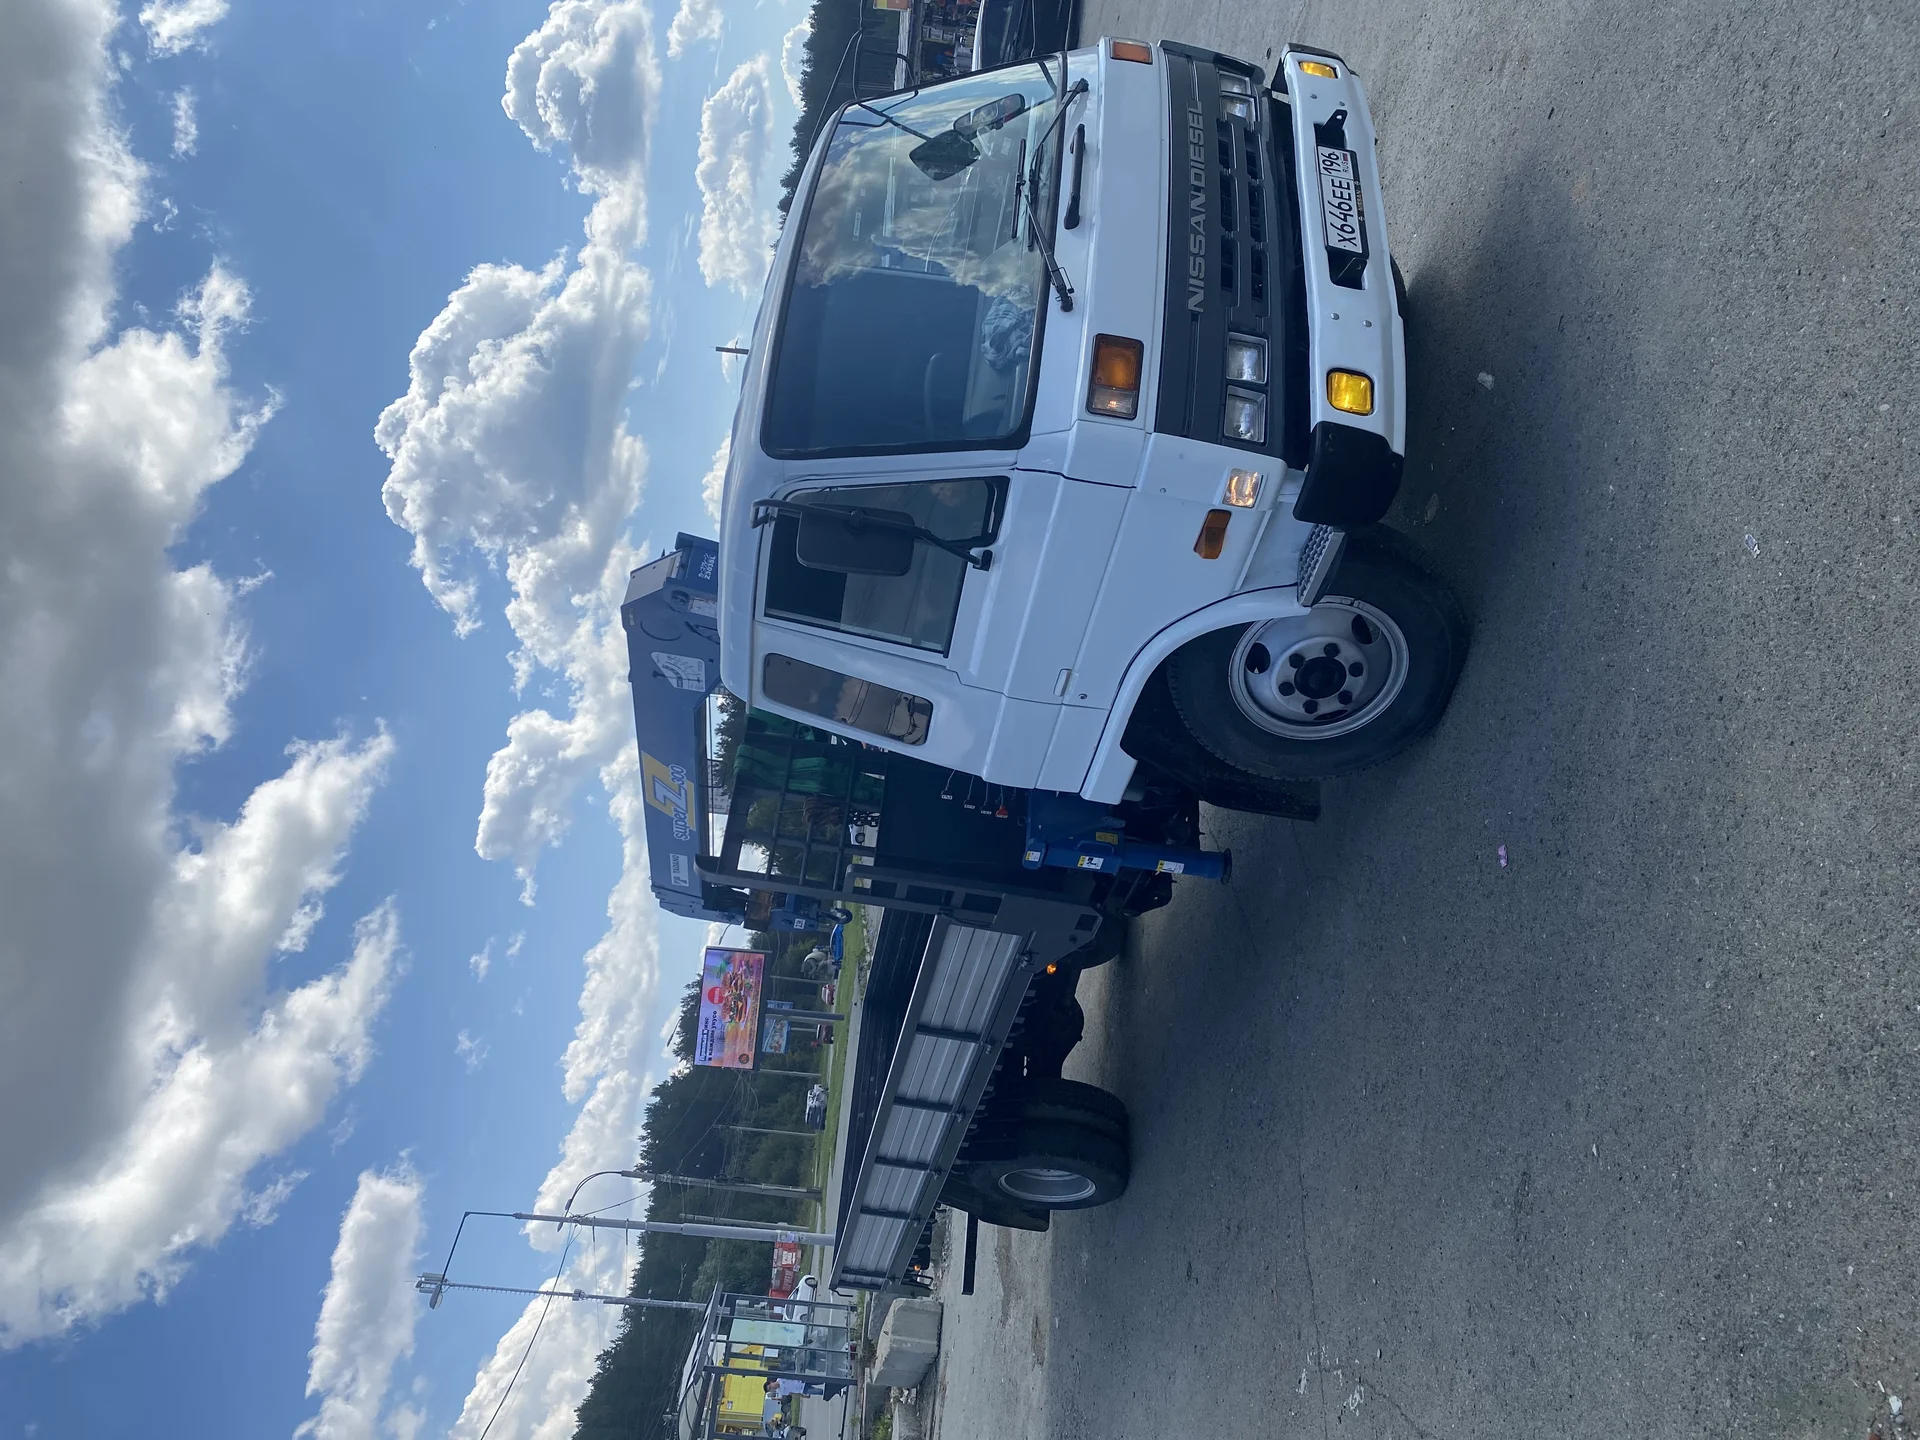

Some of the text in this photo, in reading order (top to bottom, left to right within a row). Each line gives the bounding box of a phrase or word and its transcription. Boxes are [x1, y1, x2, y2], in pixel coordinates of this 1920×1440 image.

[1321, 152, 1341, 175] 196
[1341, 162, 1349, 173] RUS
[1188, 100, 1206, 312] NISSAN DIESEL
[1356, 190, 1364, 212] NISSAN
[704, 556, 716, 580] Z303SL
[672, 809, 692, 840] super
[672, 855, 680, 874] TADANO
